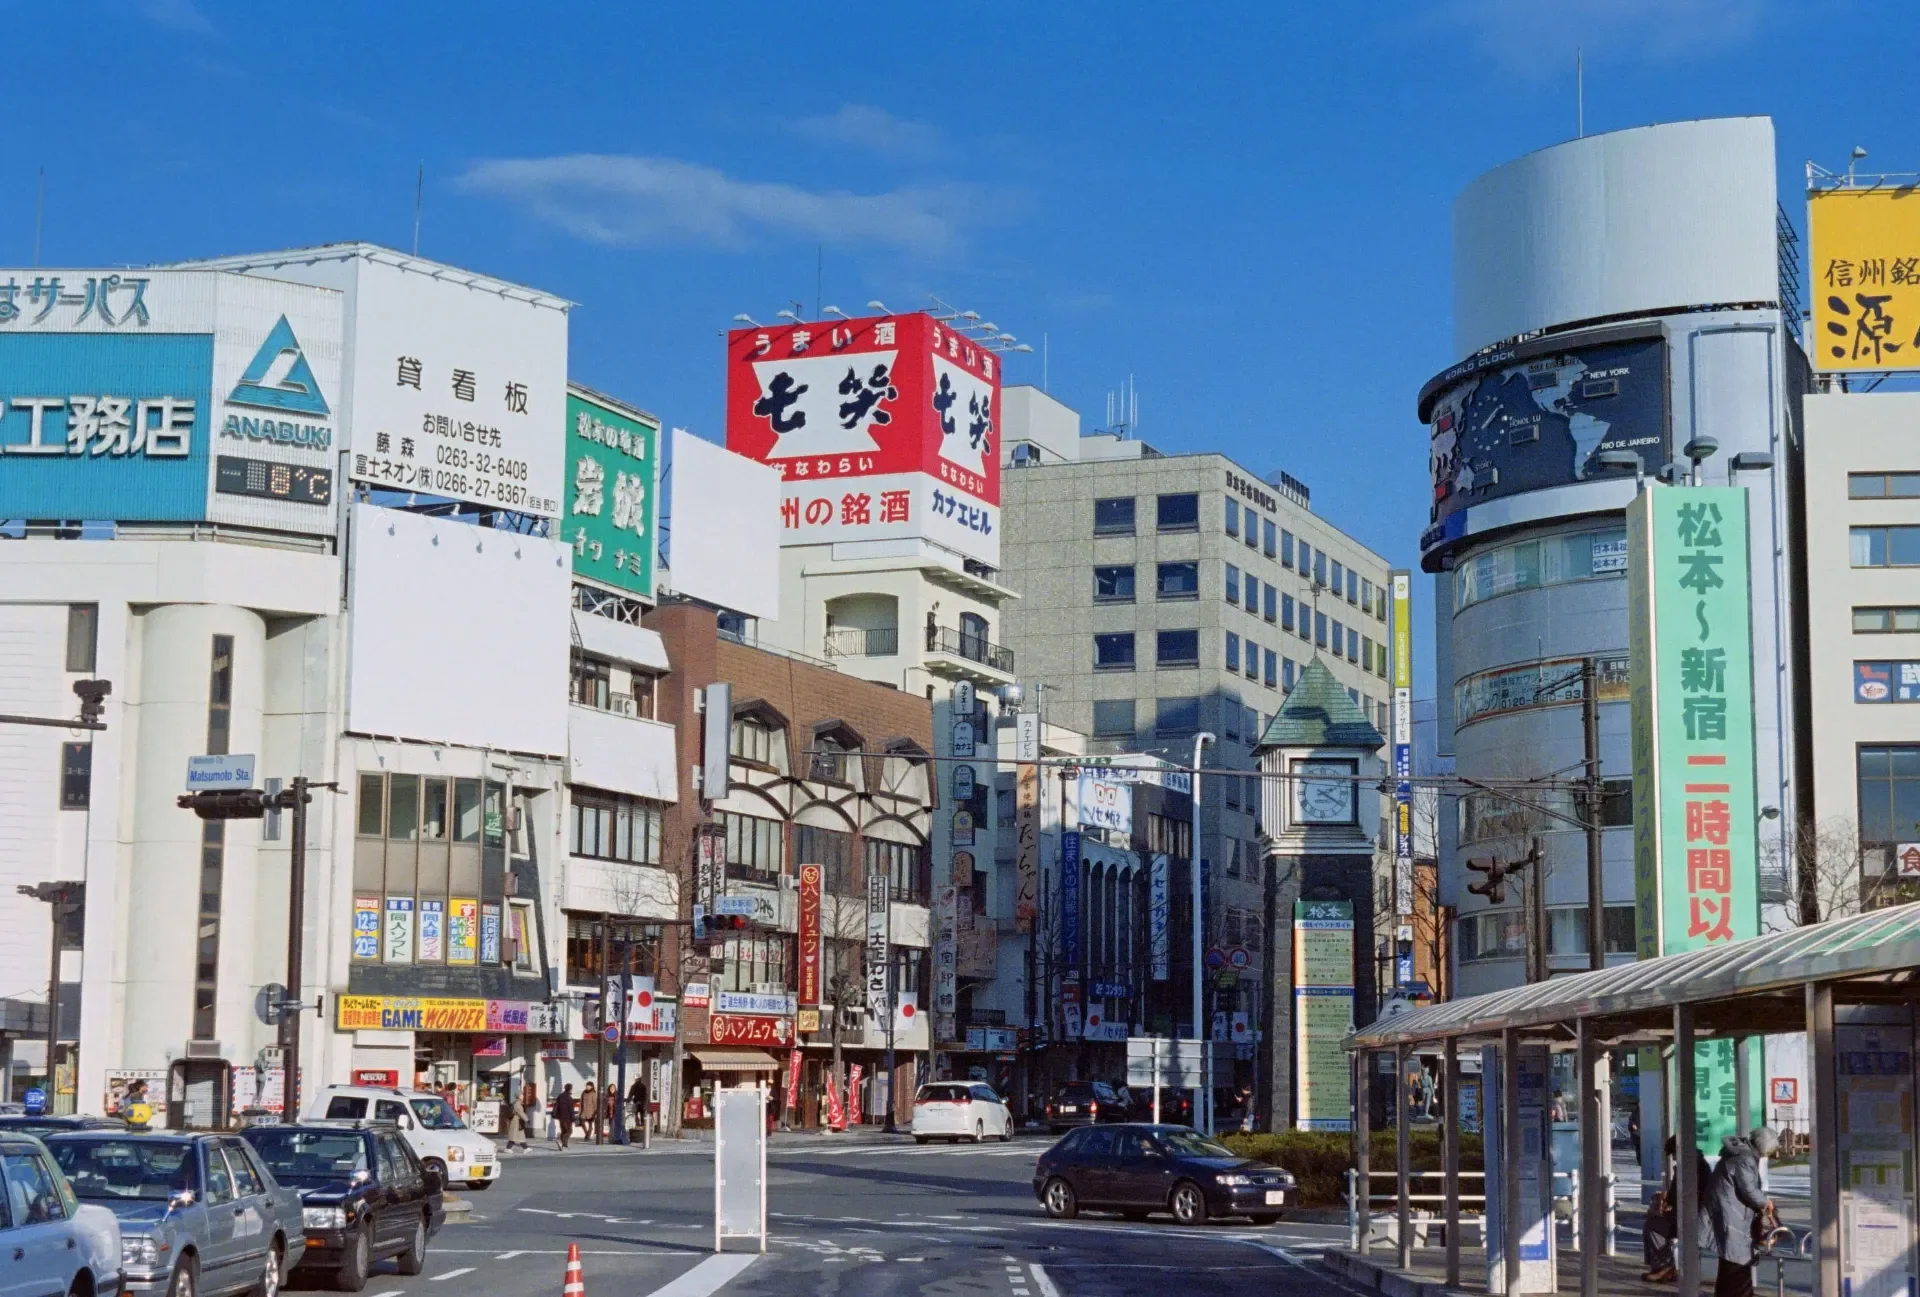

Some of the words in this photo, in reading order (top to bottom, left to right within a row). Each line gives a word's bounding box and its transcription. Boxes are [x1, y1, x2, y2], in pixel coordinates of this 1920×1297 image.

[1824, 257, 1920, 288] 信州銘
[755, 322, 897, 354] うまい酒
[1826, 292, 1920, 365] 源
[932, 326, 993, 380] うまい酒
[1445, 363, 1475, 380] WORLD
[1478, 350, 1515, 367] CLOCK
[396, 355, 529, 415] 貸看板
[1590, 371, 1607, 379] NEW
[1609, 367, 1629, 376] YORK
[0, 395, 196, 456] 工務店
[222, 415, 332, 448] ANABUKI
[423, 412, 502, 449] お問い合せ先
[1601, 441, 1614, 450] RIO
[1616, 440, 1626, 448] DE
[1627, 436, 1660, 447] JANEIRO
[376, 431, 415, 460] 藤森
[436, 444, 529, 482] 0263-32-6408
[436, 470, 528, 507] 0266-27-8367
[781, 490, 911, 529] 州の銘酒
[932, 488, 993, 536] カナエビル
[1023, 720, 1032, 757] カナエビル
[190, 769, 232, 782] Matsumoto
[1896, 846, 1920, 873] 食
[802, 885, 819, 954] ハンリュウ
[1306, 905, 1343, 919] 松本
[389, 912, 407, 959] 同人ソフト
[382, 1008, 424, 1028] GAME
[424, 1008, 485, 1029] WONDER
